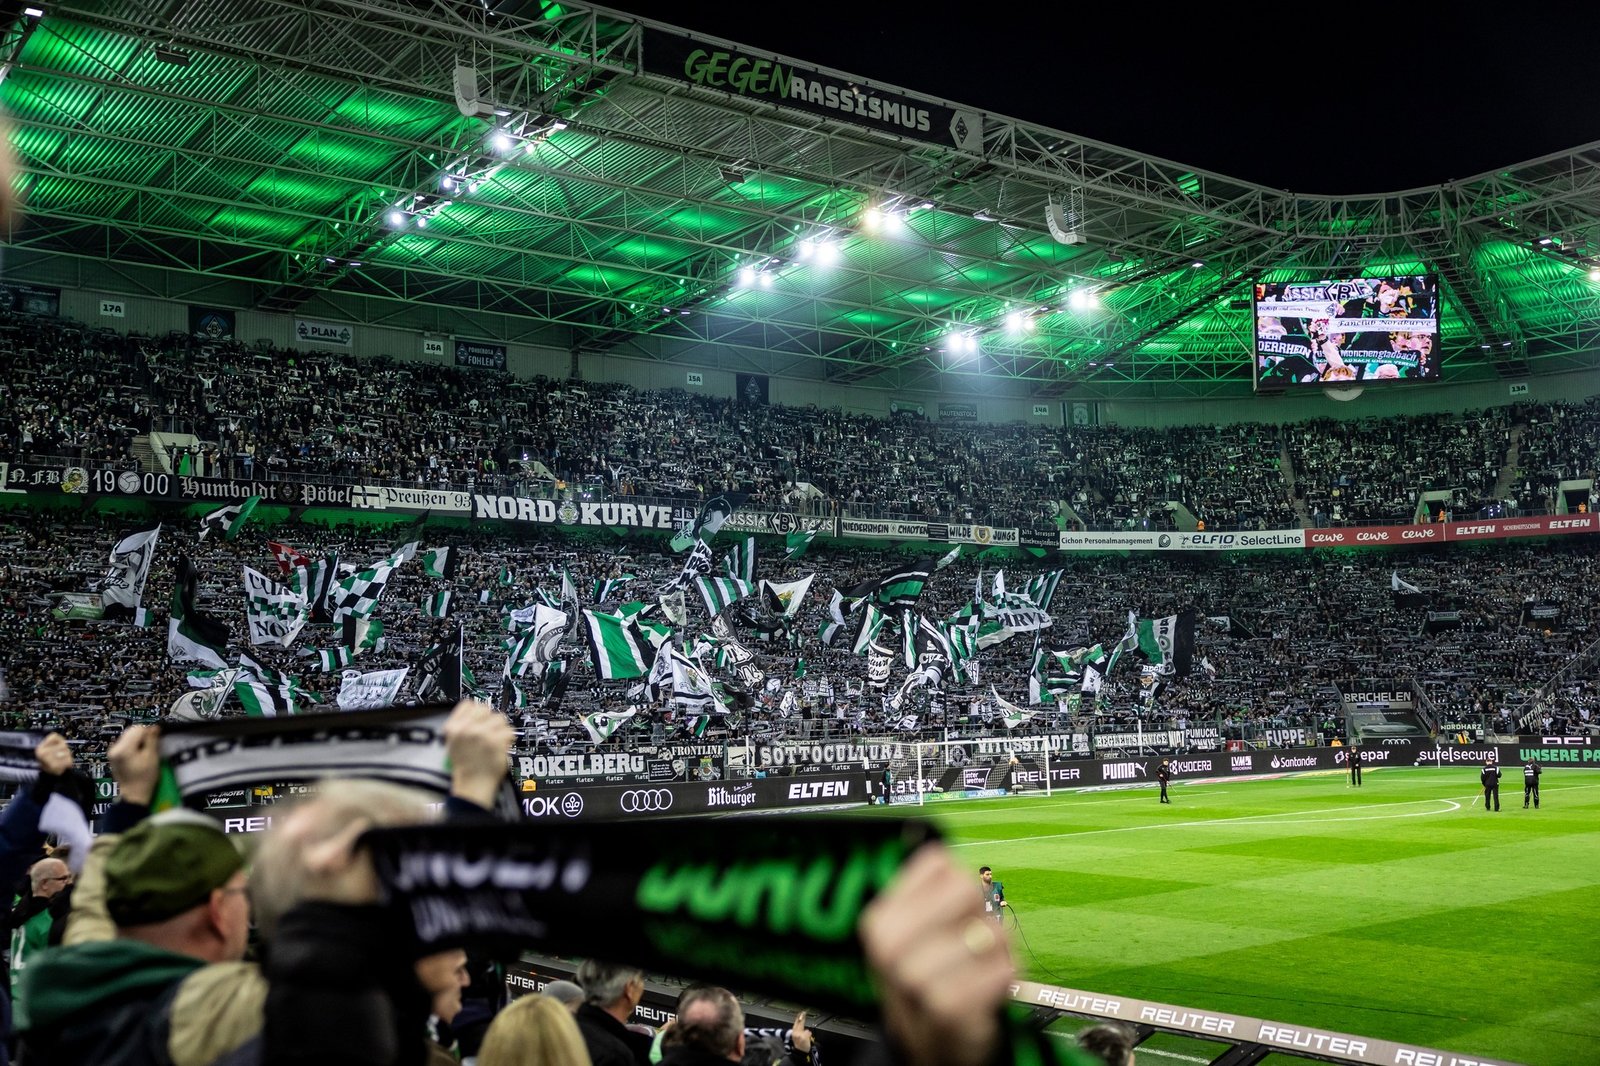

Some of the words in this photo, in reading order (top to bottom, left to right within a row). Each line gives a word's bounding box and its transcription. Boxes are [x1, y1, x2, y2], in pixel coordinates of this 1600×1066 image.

[684, 49, 793, 99] GEGEN
[791, 76, 931, 131] RASSISMUS
[103, 304, 122, 313] 17A
[311, 326, 337, 337] PLAN
[426, 343, 442, 352] 16A
[179, 477, 277, 500] Humboldt
[300, 484, 352, 506] Pöbel
[381, 488, 447, 508] Preußen
[474, 495, 556, 522] NORD
[580, 502, 672, 529] KURVE
[842, 521, 889, 534] NIEDERRHEIN
[949, 526, 971, 538] WILDE
[993, 530, 1016, 542] JUNGS
[1456, 524, 1496, 535] ELTEN
[1549, 518, 1591, 530] ELTEN
[1084, 537, 1153, 546] Personalmanagement
[1240, 534, 1301, 546] SelectLine
[1312, 533, 1345, 542] cewe
[1356, 531, 1390, 541] cewe
[1401, 528, 1435, 539] cewe
[1343, 691, 1411, 702] BRACHELEN
[1185, 728, 1219, 739] PUMUCKL
[1440, 723, 1482, 731] NORDHARZ
[671, 744, 724, 756] FRONTLINE
[975, 734, 1070, 753] VITUSSTADT
[759, 743, 903, 765] SOTTOCULTURA
[1280, 755, 1317, 768] Santander
[1345, 750, 1390, 763] separ
[1519, 748, 1580, 762] UNSERE
[518, 752, 644, 777] BÖKELBERG
[1102, 762, 1136, 780] PUMA
[1178, 760, 1212, 773] KYOCERA
[1017, 768, 1080, 783] REUTER
[707, 786, 756, 807] Bitburger
[788, 780, 850, 800] ELTEN
[505, 973, 535, 991] EUTER
[635, 1004, 679, 1023] REUTE
[1037, 988, 1121, 1015] REUTER
[1140, 1006, 1236, 1034] REUTER
[1258, 1024, 1368, 1057] REUTER
